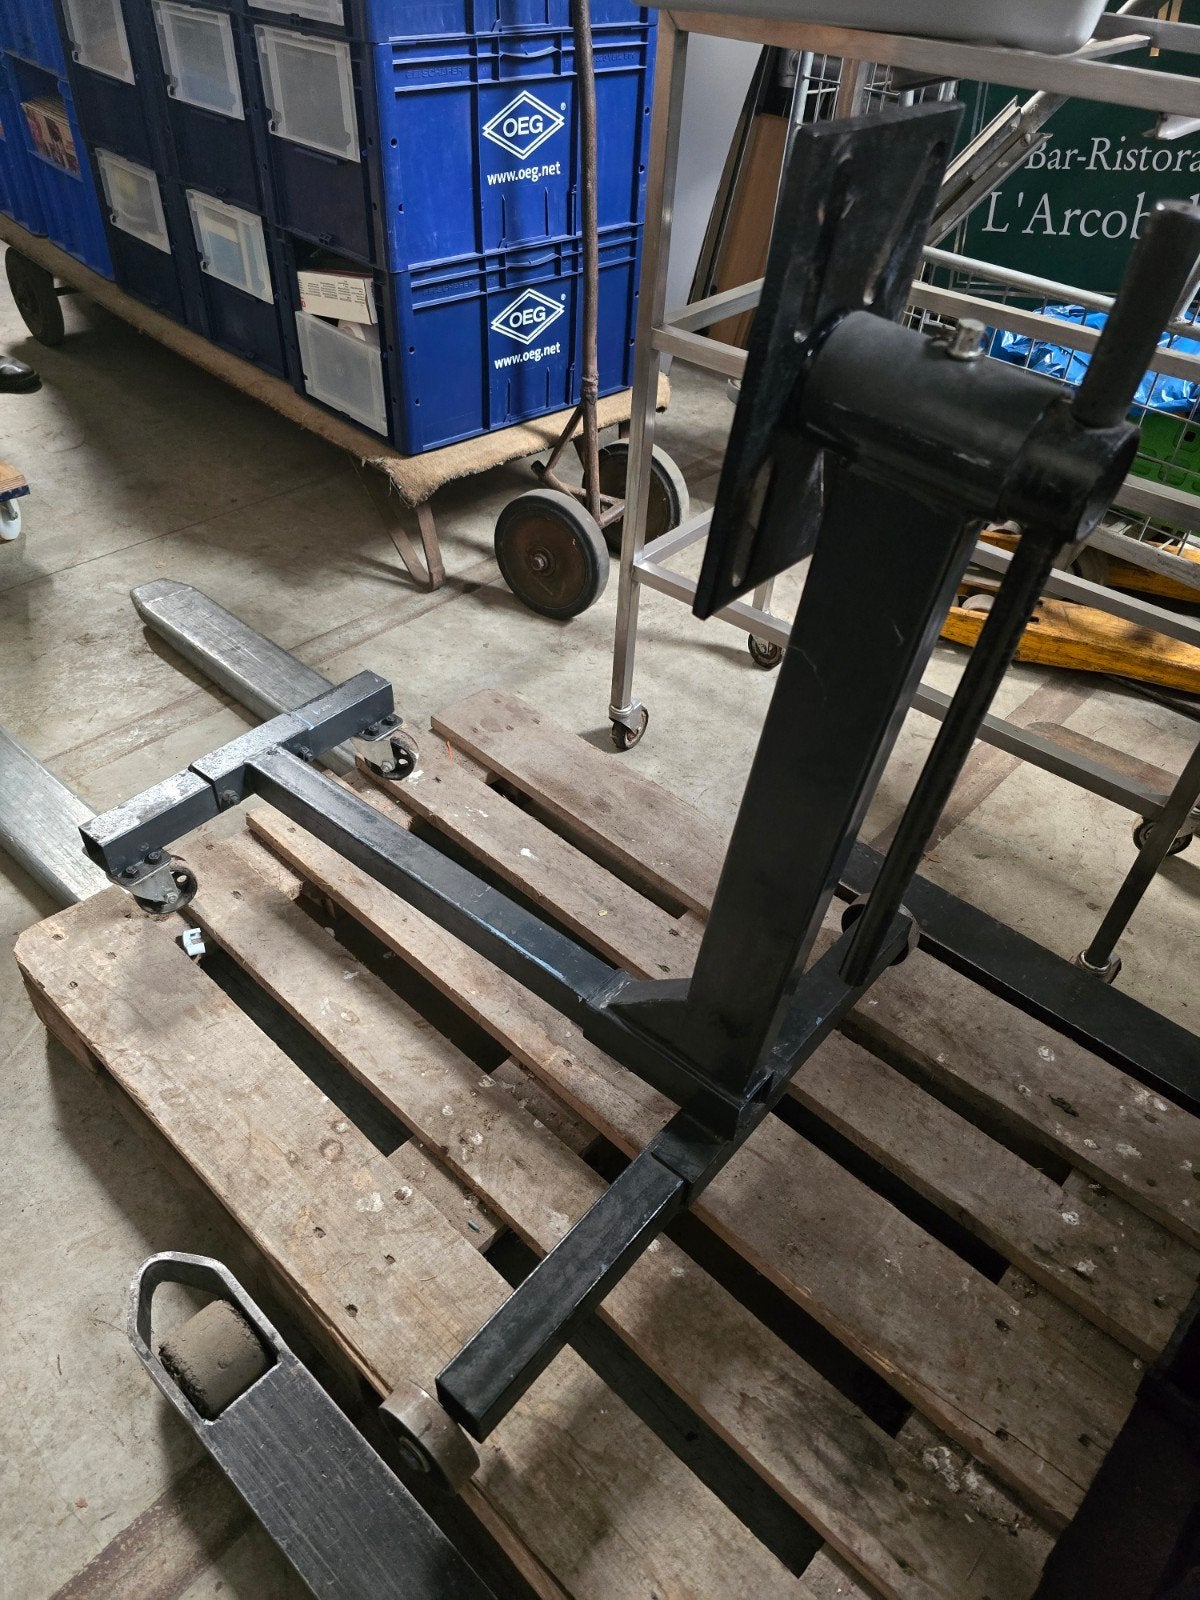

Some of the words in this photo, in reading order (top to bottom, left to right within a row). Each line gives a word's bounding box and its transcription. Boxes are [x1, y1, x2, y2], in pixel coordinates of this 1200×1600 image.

[502, 114, 544, 138] OEG
[486, 161, 561, 186] www.oeg.net
[508, 305, 547, 329] OEG
[493, 341, 561, 370] www.oeg.net
